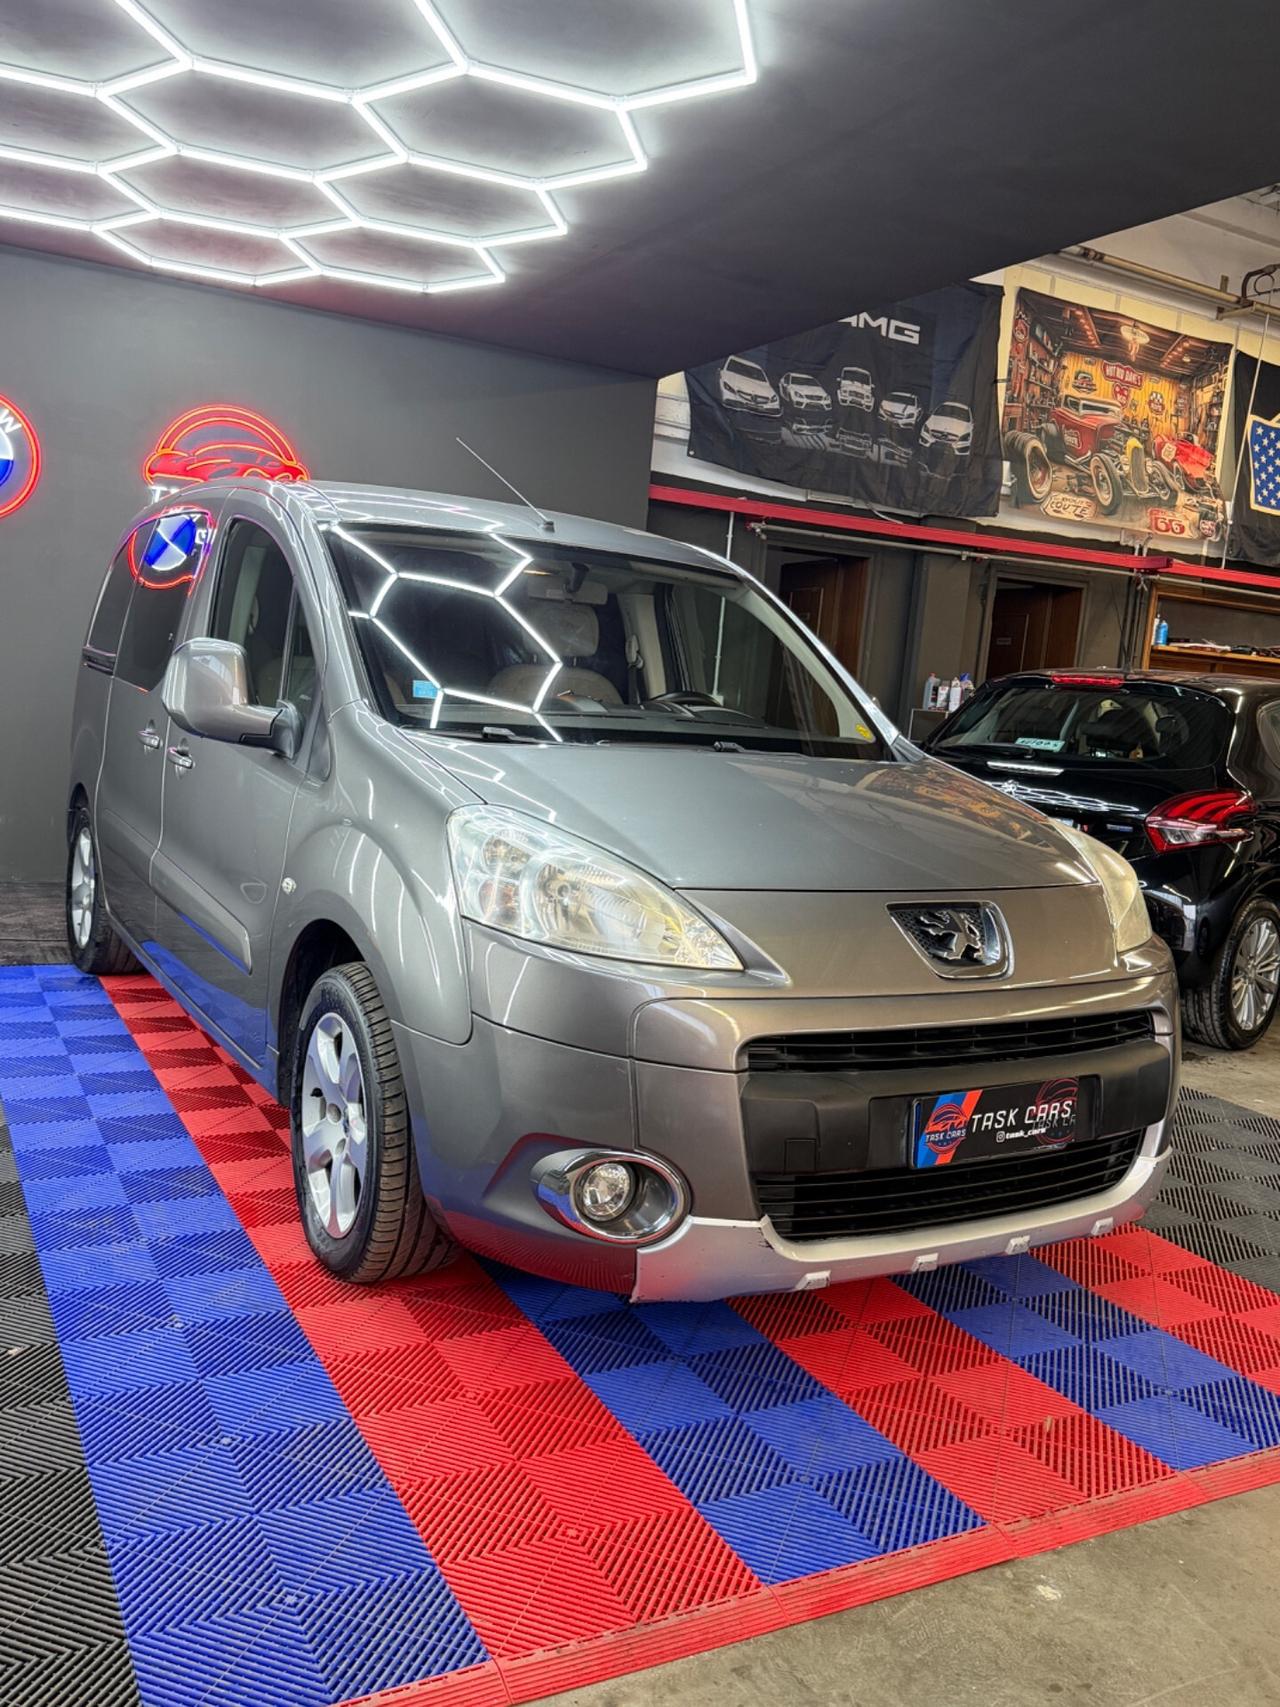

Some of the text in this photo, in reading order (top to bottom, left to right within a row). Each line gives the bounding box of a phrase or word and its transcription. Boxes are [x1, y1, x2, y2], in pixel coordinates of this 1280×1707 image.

[1156, 517, 1184, 534] 66
[972, 1100, 1072, 1133] TASK CARS
[925, 1132, 945, 1142] TASK
